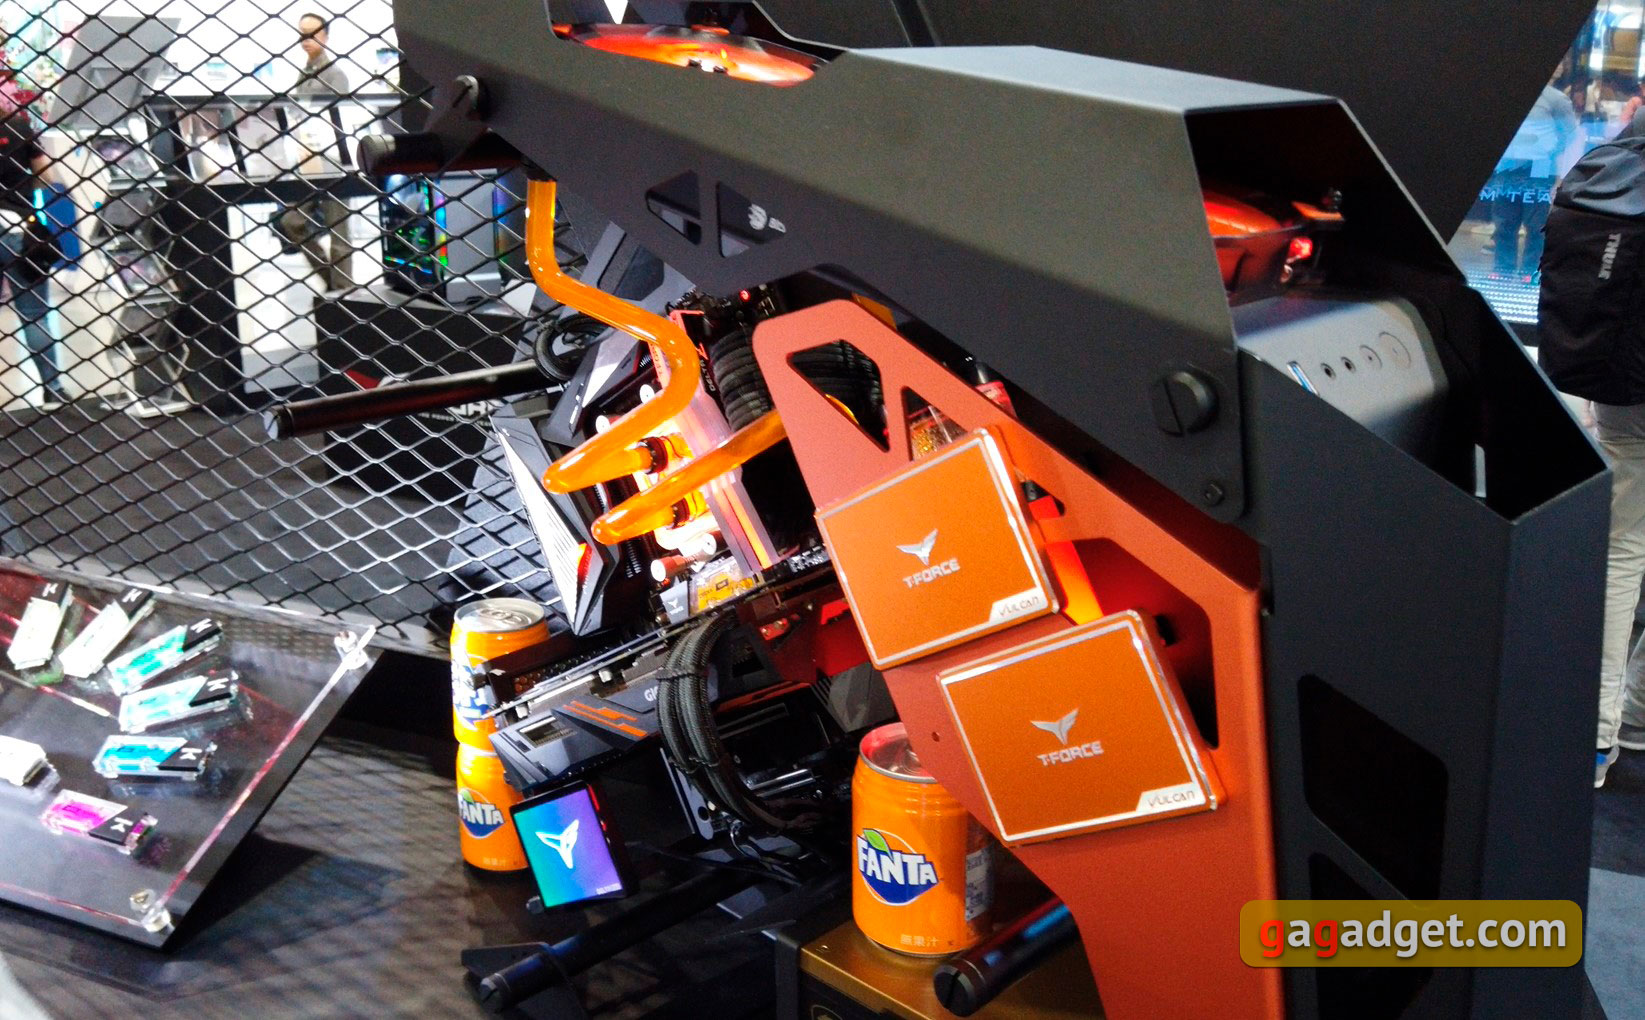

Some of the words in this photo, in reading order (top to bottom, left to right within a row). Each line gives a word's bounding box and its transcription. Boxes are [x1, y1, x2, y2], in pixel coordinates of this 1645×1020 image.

[1508, 191, 1553, 204] TEA
[1598, 233, 1621, 279] THULE
[856, 836, 938, 885] FANTA
